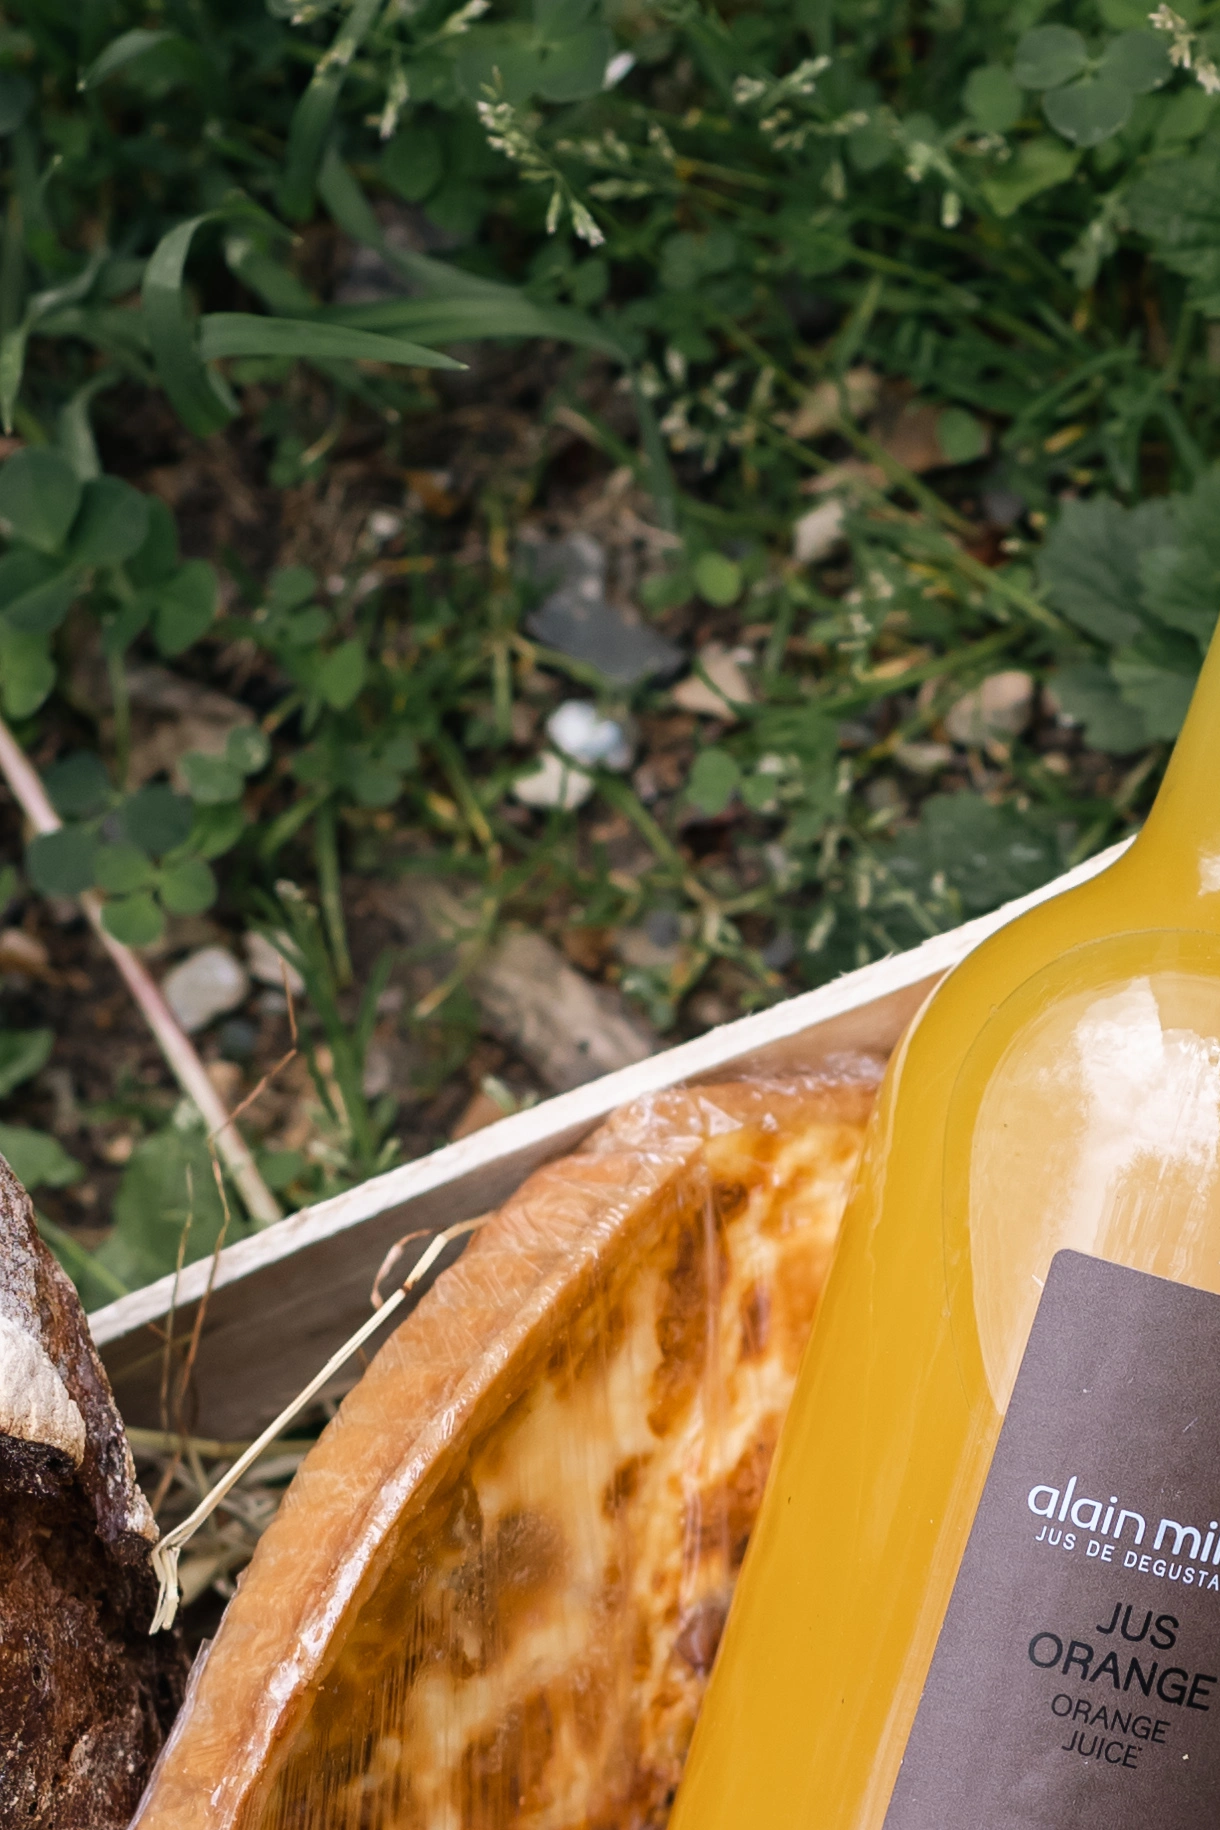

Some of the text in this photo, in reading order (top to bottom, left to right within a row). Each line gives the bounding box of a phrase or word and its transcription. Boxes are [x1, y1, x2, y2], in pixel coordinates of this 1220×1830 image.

[1027, 1475, 1146, 1546] alain
[1034, 1525, 1077, 1551] JUS
[1085, 1538, 1116, 1563] DE
[1096, 1602, 1180, 1650] JUS
[1028, 1631, 1218, 1712] ORANGE
[1050, 1693, 1171, 1744] ORANGE
[1061, 1730, 1143, 1769] JUICE
